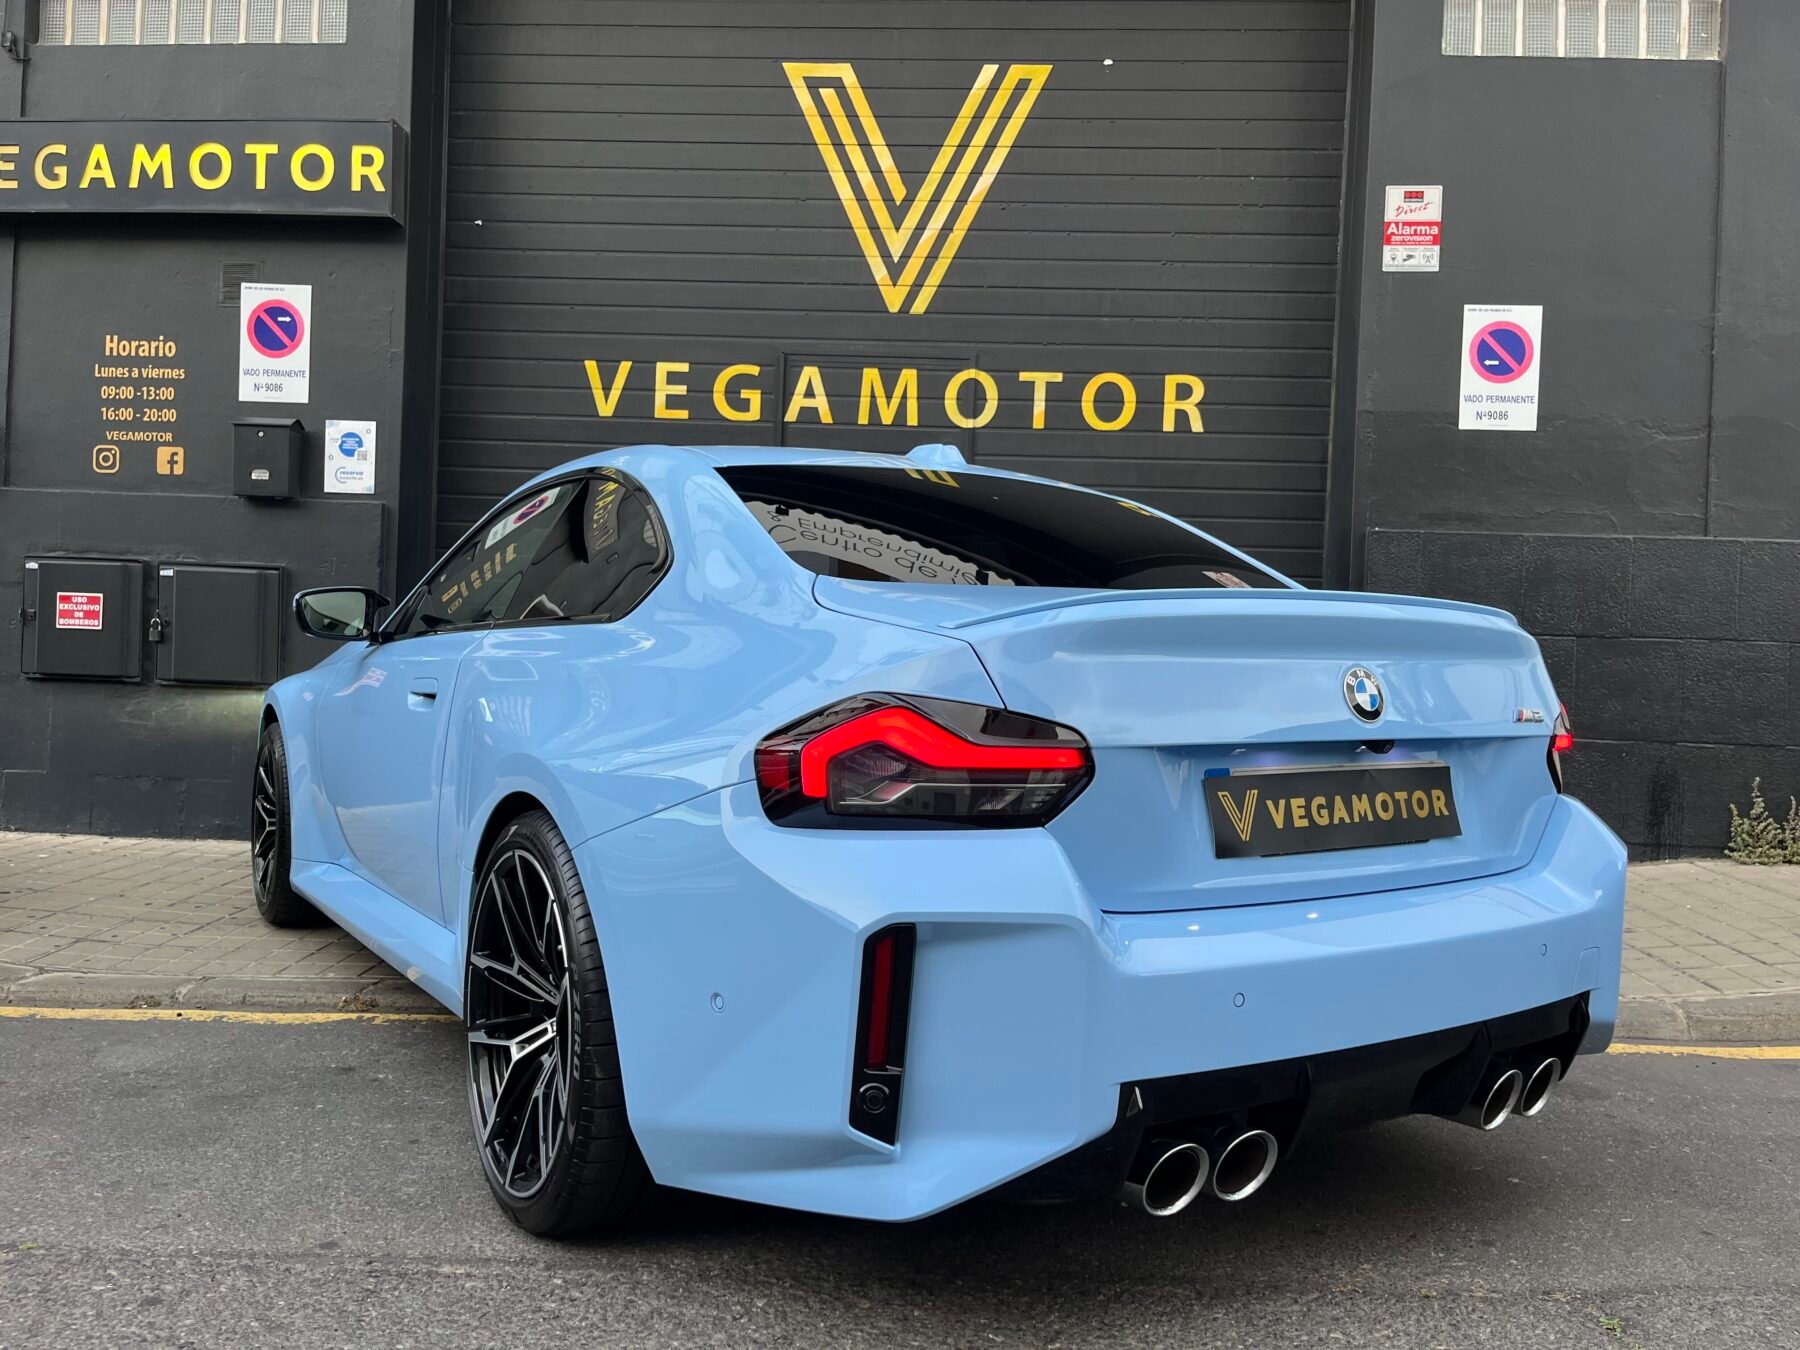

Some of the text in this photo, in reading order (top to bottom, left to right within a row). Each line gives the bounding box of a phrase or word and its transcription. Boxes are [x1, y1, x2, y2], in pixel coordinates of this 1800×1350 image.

[1386, 222, 1439, 235] Alarma
[105, 334, 177, 358] Horario
[95, 363, 185, 380] Lunes a viernes
[242, 368, 307, 379] VADO PERMANENTE
[100, 385, 134, 400] 09:00
[584, 359, 1206, 433] VEGAMOTOR
[1463, 394, 1535, 404] VADO PERMANENTE
[100, 407, 134, 421] 16:00
[142, 408, 177, 422] 20:00
[105, 431, 173, 442] VEGAMOTOR
[59, 603, 100, 611] EXCLUSIVO
[58, 618, 99, 626] BOMBEROS
[1266, 789, 1450, 830] VEGAMOTOR
